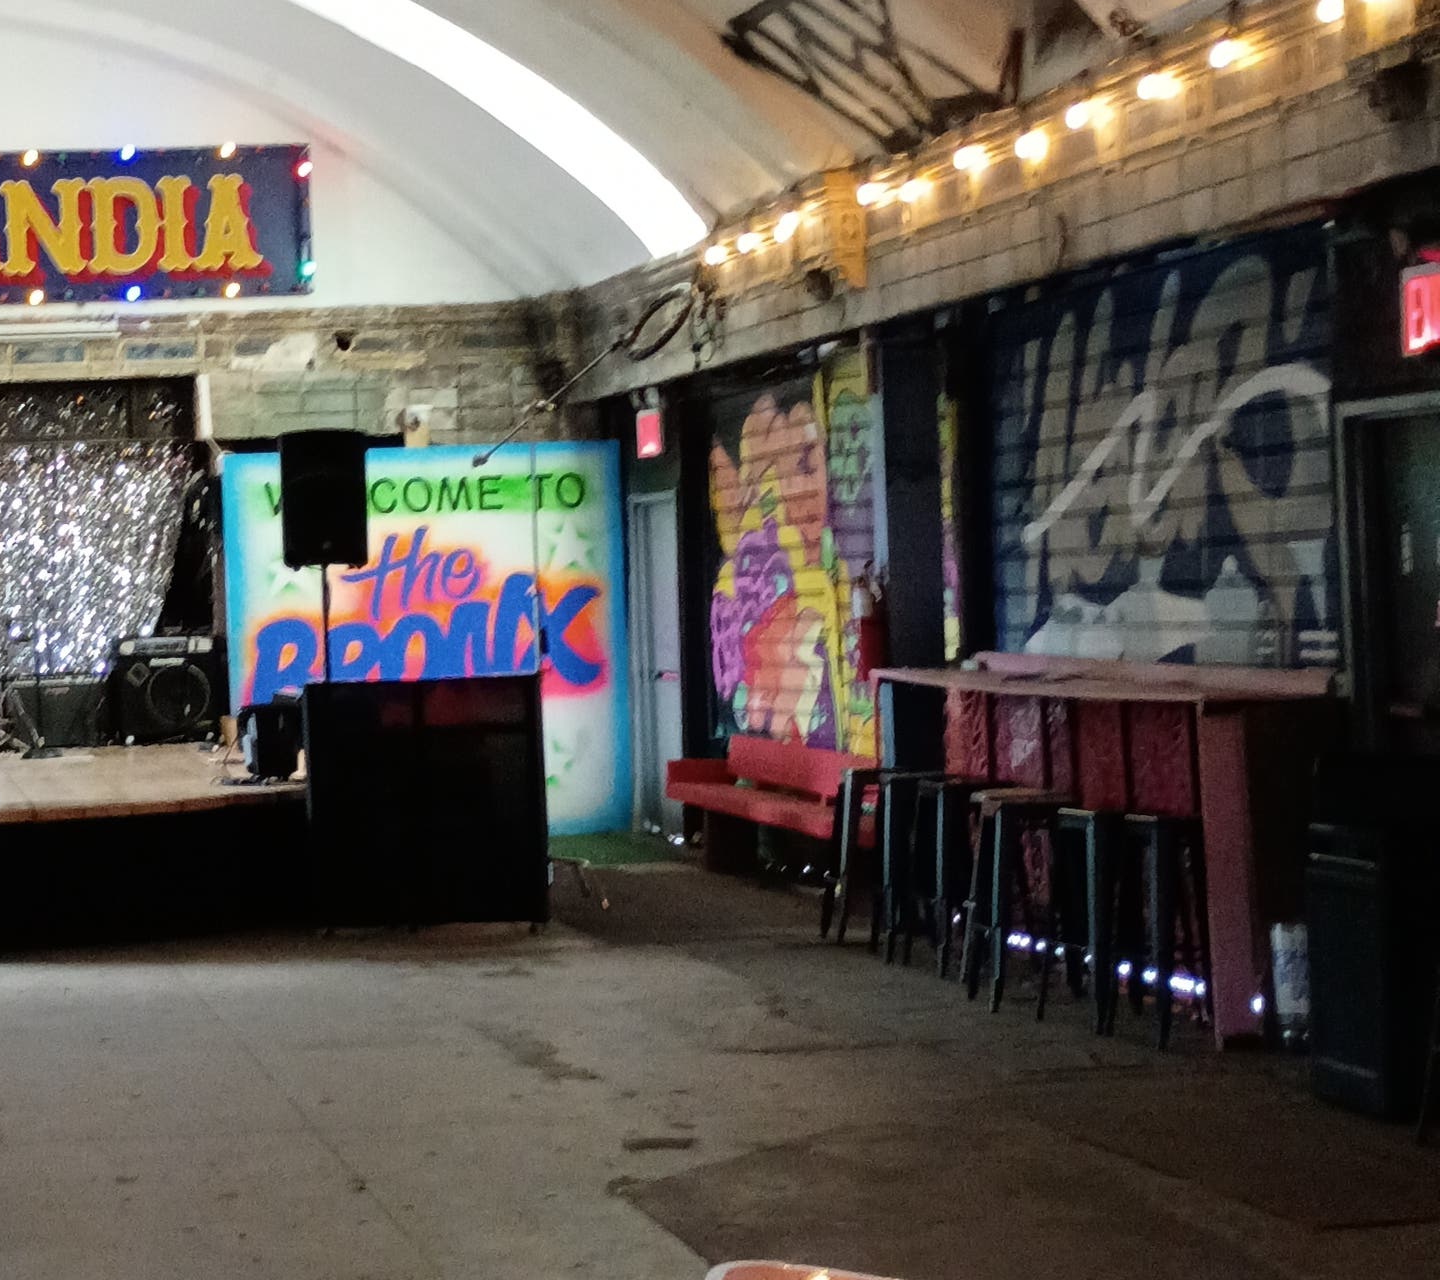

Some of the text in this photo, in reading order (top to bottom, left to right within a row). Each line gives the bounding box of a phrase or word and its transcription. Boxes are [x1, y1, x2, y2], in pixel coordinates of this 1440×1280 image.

[264, 471, 586, 516] COME TO
[340, 525, 479, 621] the
